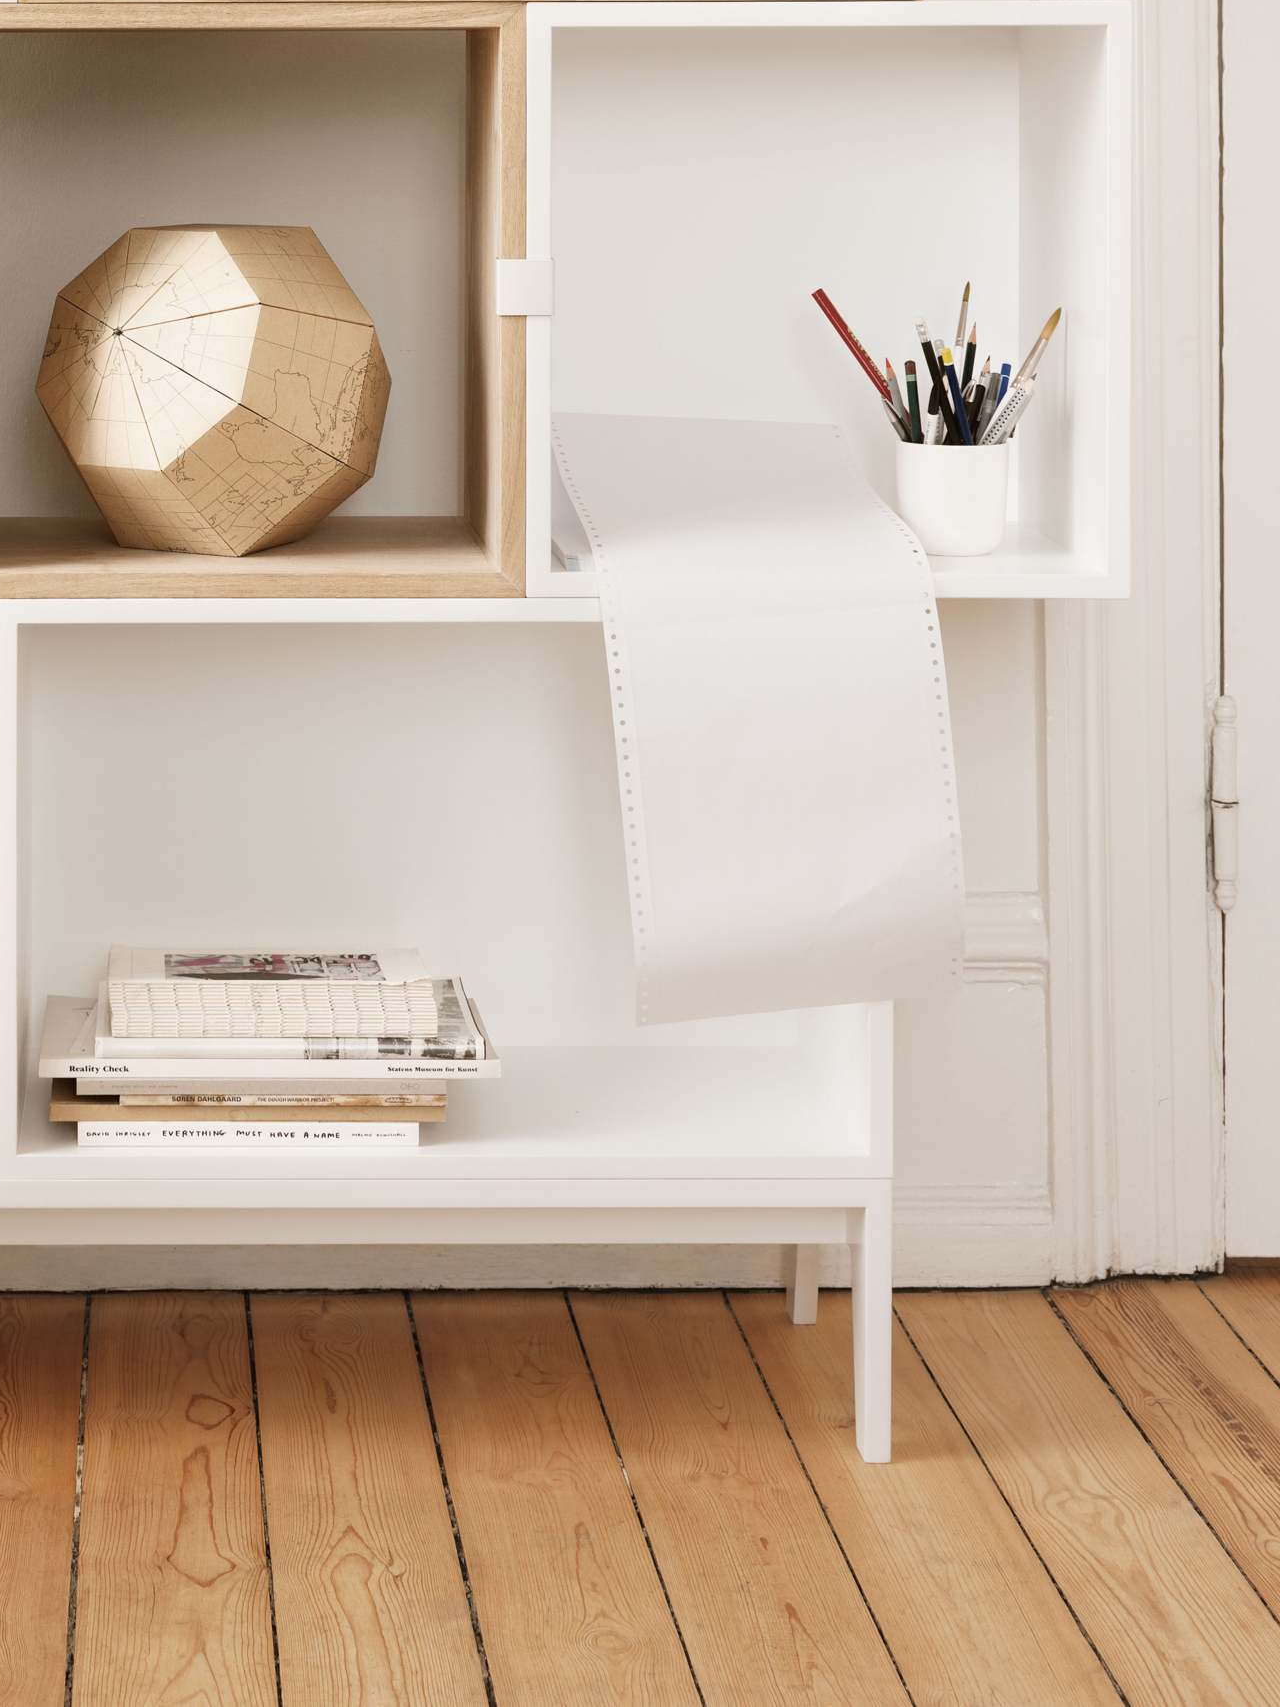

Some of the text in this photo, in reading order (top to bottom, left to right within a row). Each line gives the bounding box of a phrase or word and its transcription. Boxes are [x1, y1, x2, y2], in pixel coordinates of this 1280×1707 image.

[69, 1065, 129, 1074] Reality Check
[162, 1129, 226, 1137] EVERYTHING
